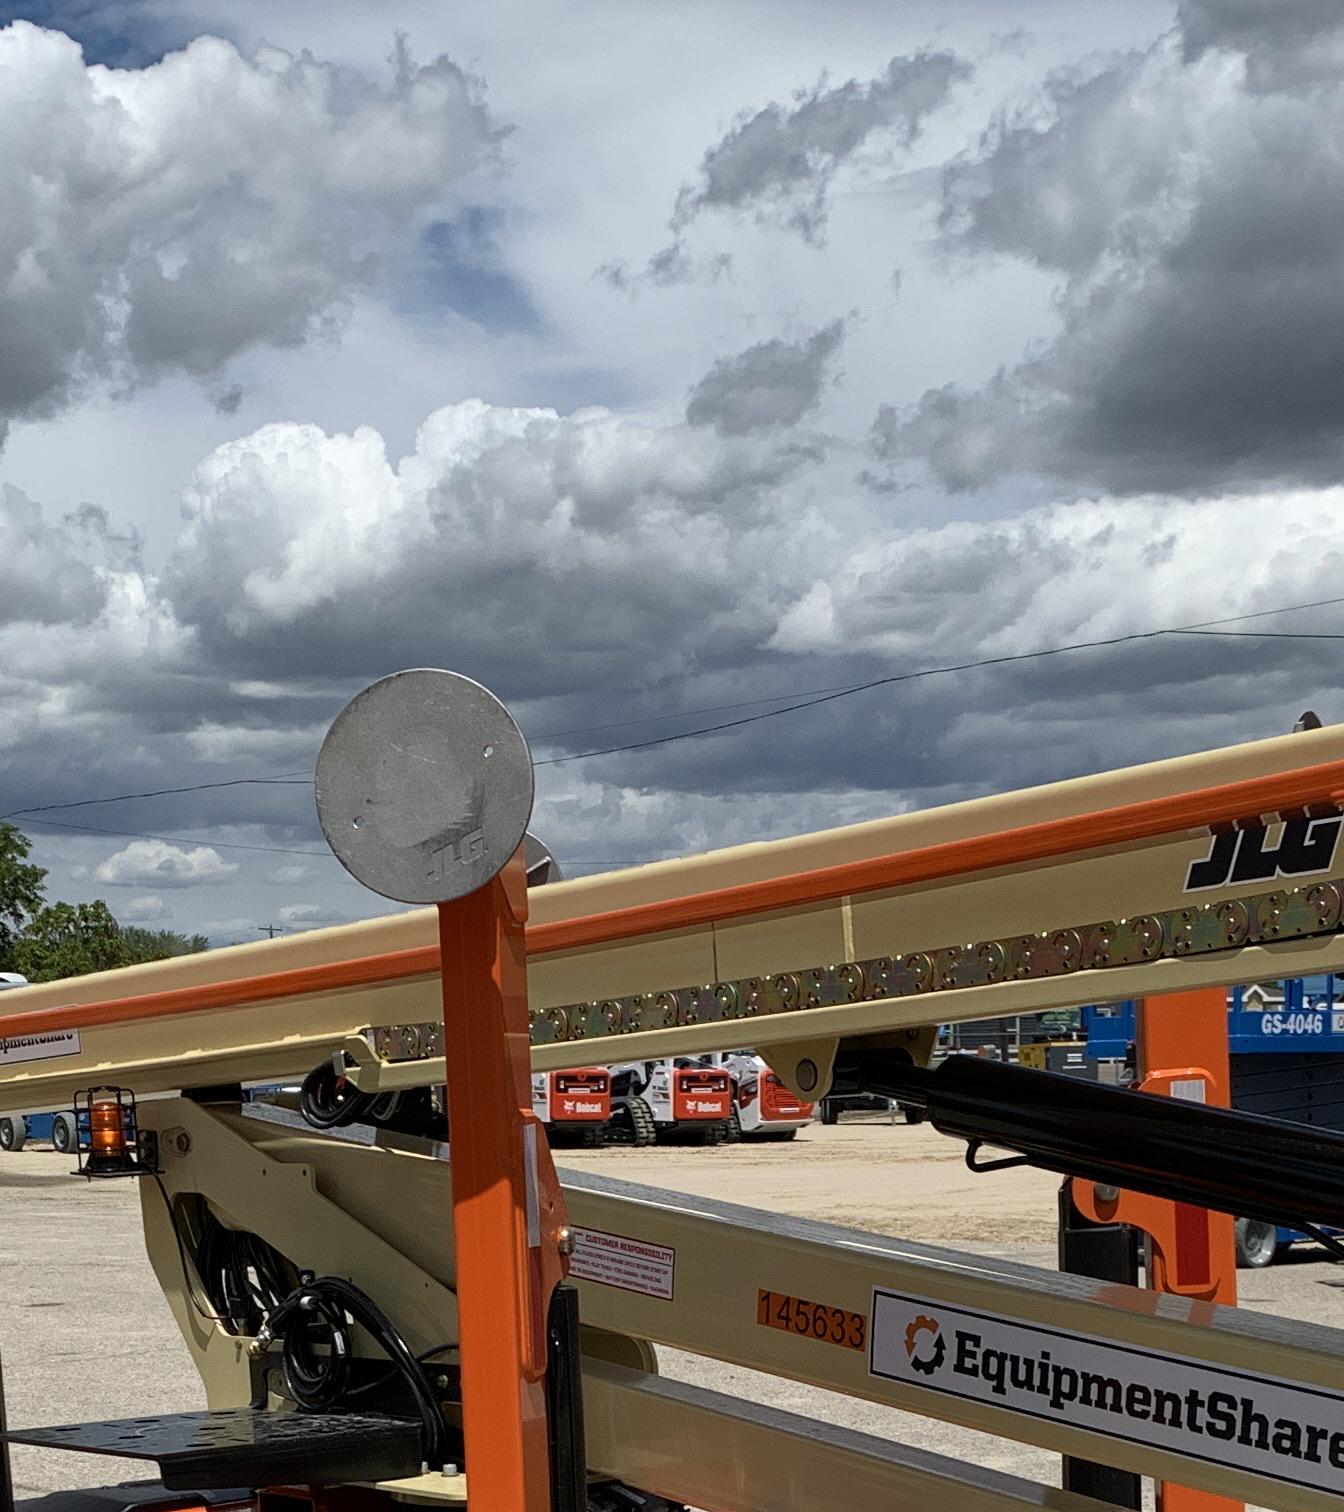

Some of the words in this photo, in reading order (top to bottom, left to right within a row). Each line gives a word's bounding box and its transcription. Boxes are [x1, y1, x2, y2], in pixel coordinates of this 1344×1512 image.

[1261, 1013, 1323, 1034] GS-4046
[575, 1102, 602, 1113] Bobcat
[697, 1102, 722, 1113] Bobcat
[761, 1290, 865, 1349] 145633
